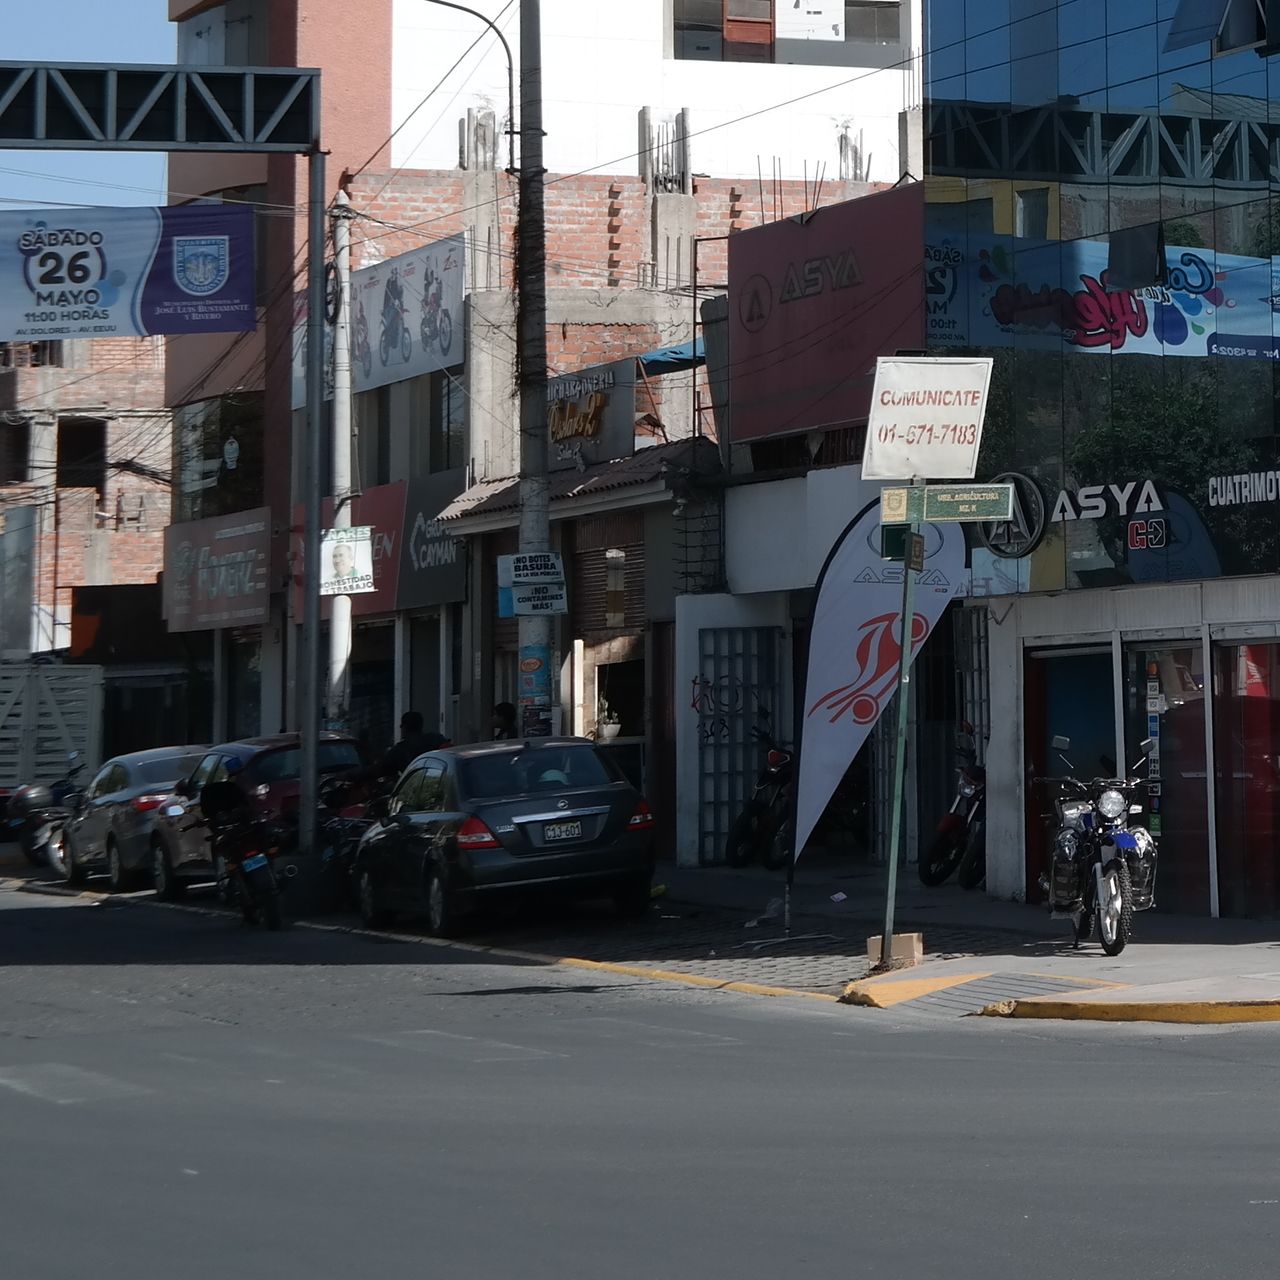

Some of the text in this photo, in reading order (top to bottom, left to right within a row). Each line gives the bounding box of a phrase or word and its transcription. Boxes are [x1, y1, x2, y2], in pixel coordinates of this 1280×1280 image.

[20, 228, 104, 248] SÁBADO
[38, 251, 92, 285] 26
[779, 246, 864, 305] ASYA
[36, 289, 101, 308] MAYO
[24, 308, 110, 323] 11:00 HORAS
[880, 389, 981, 407] COMUNICATE
[878, 423, 977, 445] 01-671-7183
[1051, 480, 1165, 523] ASYA
[418, 539, 457, 569] CAYMAN
[528, 554, 551, 564] BOTES
[514, 562, 557, 573] BASURA
[331, 581, 374, 594] TRABAJO
[517, 593, 564, 604] CONTAMINES
